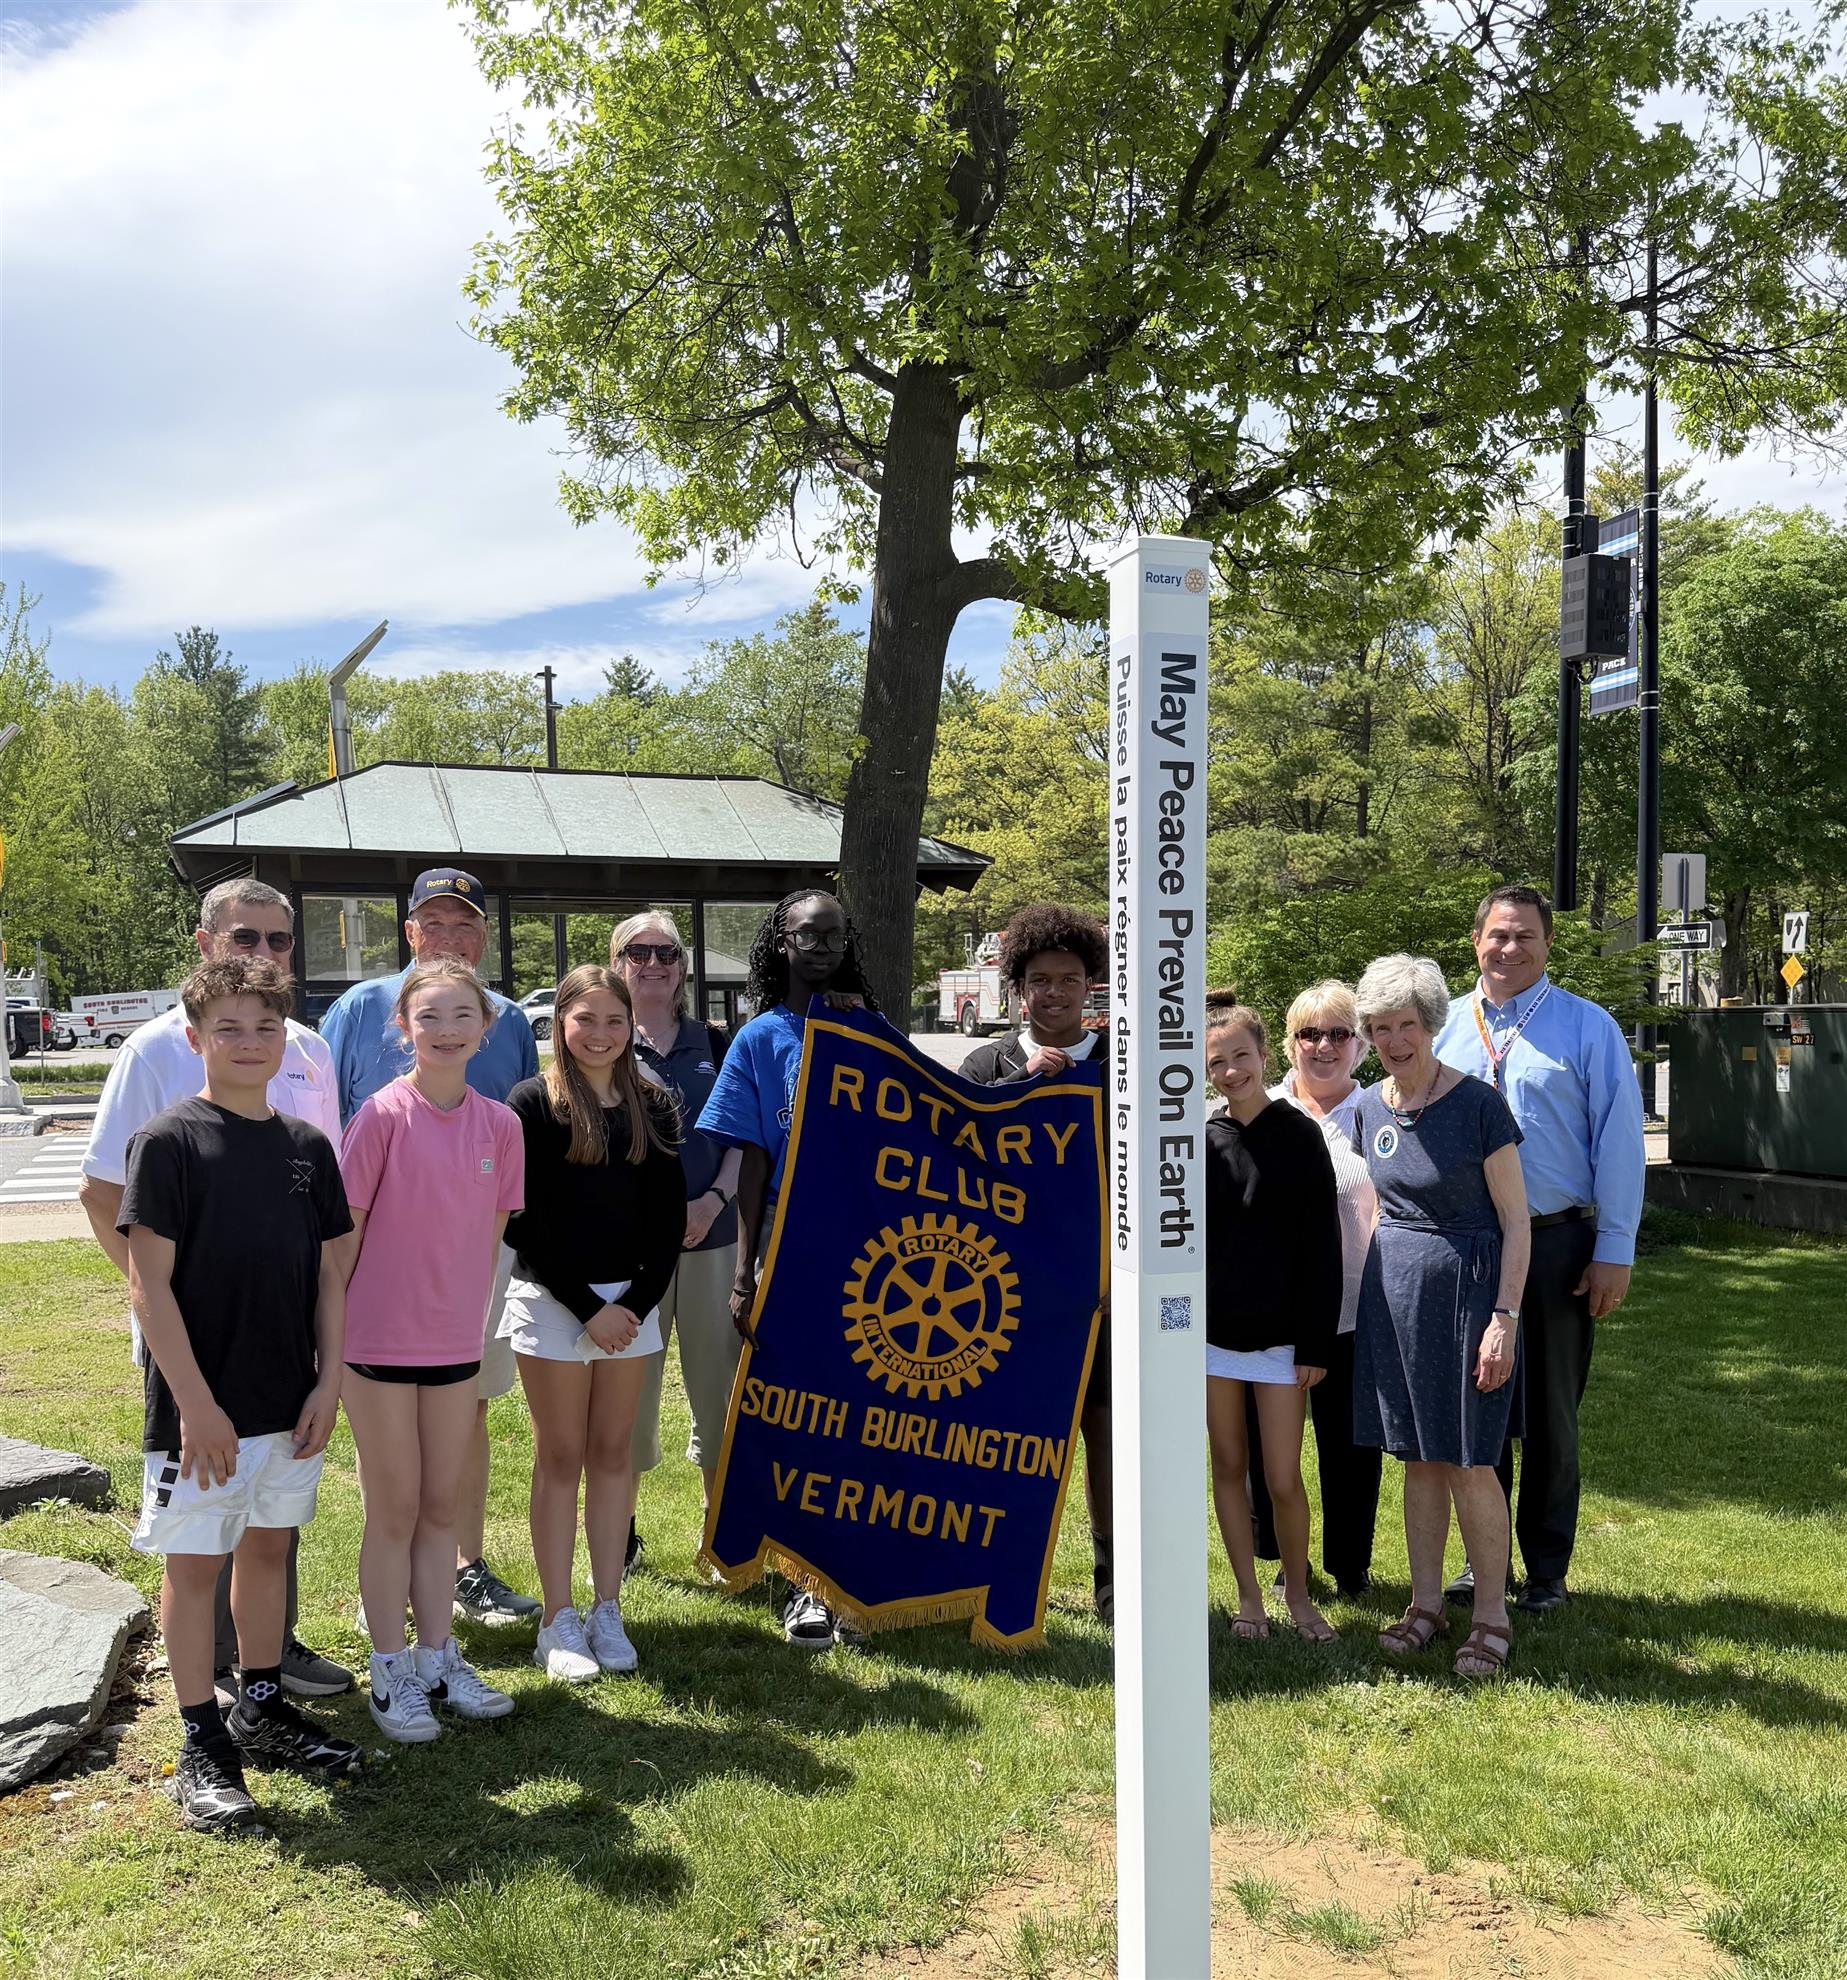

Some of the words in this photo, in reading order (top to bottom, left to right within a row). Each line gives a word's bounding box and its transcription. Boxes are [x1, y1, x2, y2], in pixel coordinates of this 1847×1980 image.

[1145, 571, 1182, 587] Rotary
[1151, 652, 1197, 749] May
[1602, 656, 1627, 672] PACK
[1116, 654, 1131, 767] Puisse
[1116, 776, 1131, 806] la
[1158, 760, 1195, 896] Peace
[426, 878, 452, 889] Rotary
[1114, 815, 1131, 886] paix
[1114, 895, 1131, 1007] régner
[1686, 930, 1704, 942] WAY
[1158, 909, 1195, 1051] Prevail
[1116, 1015, 1131, 1094] dans
[1791, 1034, 1803, 1045] SW
[829, 1063, 1079, 1166] ROTARY
[1117, 1103, 1131, 1131] le
[1158, 1063, 1195, 1122] On
[874, 1146, 1027, 1225] CLUB
[1116, 1141, 1132, 1251] monde
[903, 1234, 989, 1271] ROTARY
[862, 1317, 988, 1381] INTERNATIONAL
[741, 1376, 849, 1439] SOUTH
[860, 1406, 1066, 1480] BURLINGTON
[772, 1460, 1006, 1548] VERMONT
